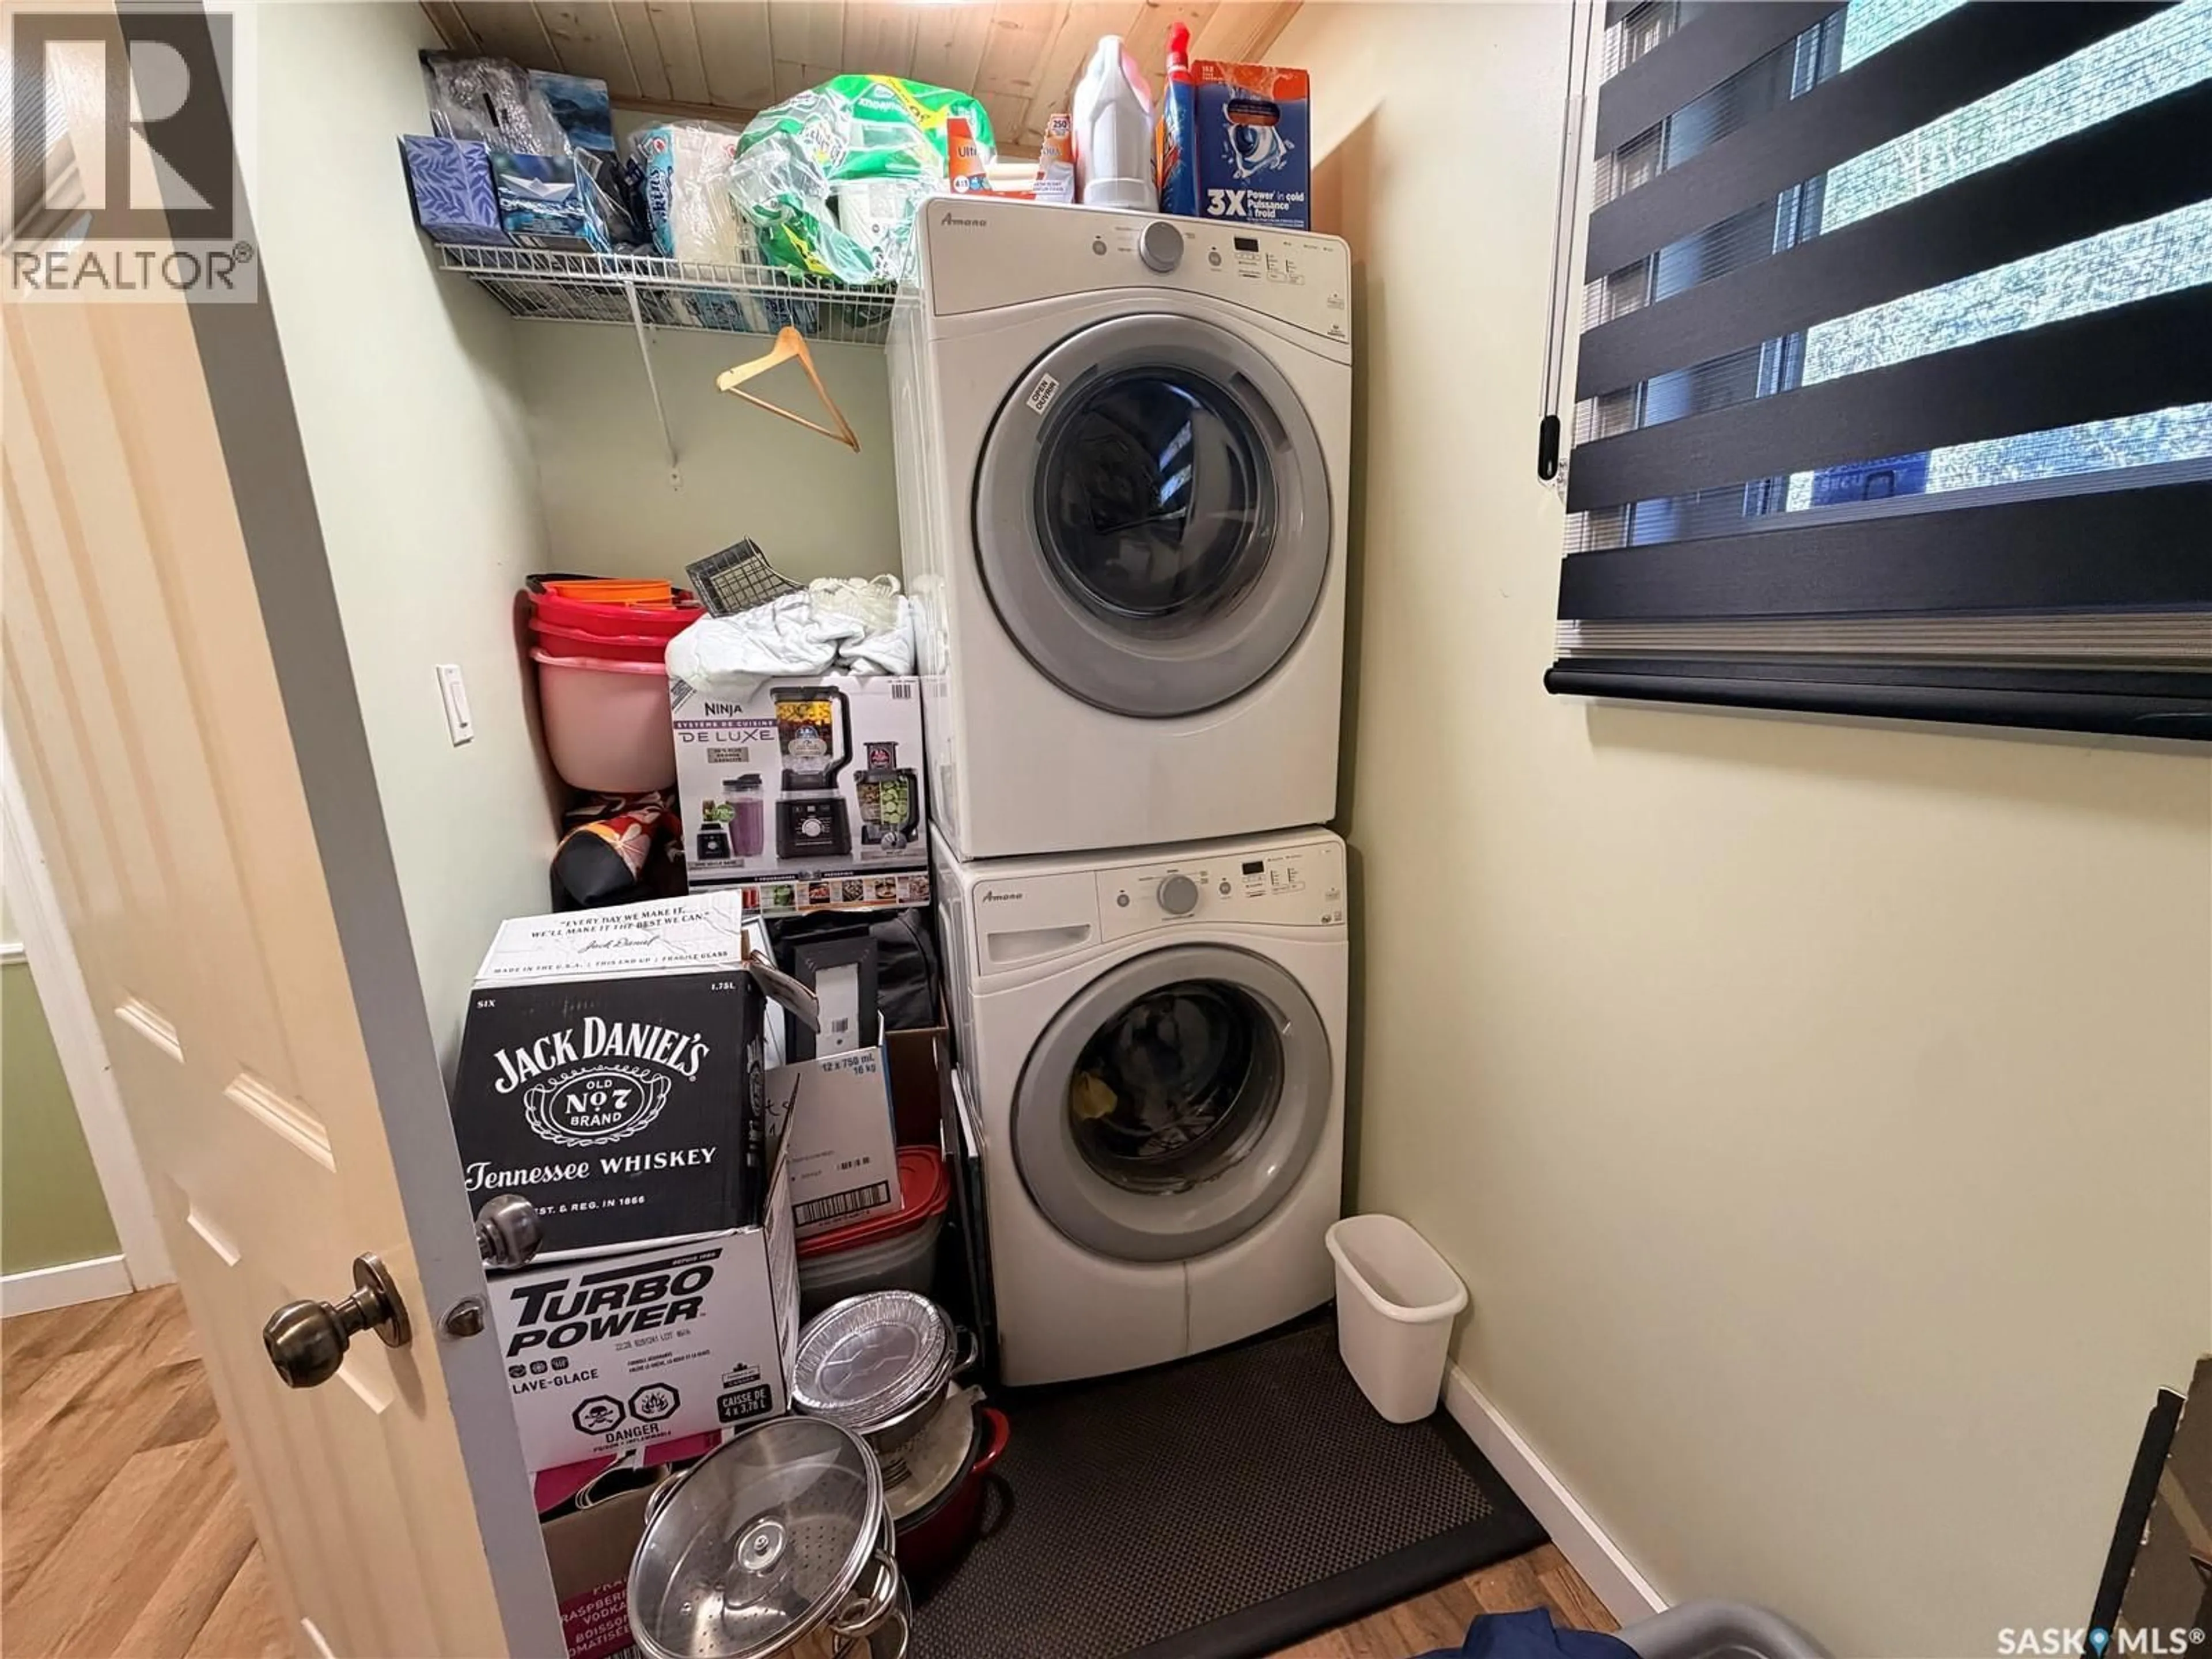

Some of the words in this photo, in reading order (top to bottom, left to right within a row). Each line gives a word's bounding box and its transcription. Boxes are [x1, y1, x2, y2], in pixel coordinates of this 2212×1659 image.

[1207, 188, 1247, 216] 3X
[1247, 190, 1274, 200] Power
[1277, 191, 1285, 201] in
[1286, 192, 1305, 202] cold
[1248, 199, 1290, 210] Puissance
[941, 213, 988, 227] Amana
[1255, 209, 1276, 218] froid
[1032, 380, 1048, 402] OPEN
[704, 702, 743, 717] NINJA
[982, 890, 1023, 904] Amana
[603, 915, 622, 924] DAY
[624, 913, 639, 921] WE
[641, 910, 670, 920] MAKE
[566, 926, 596, 935] MAKE
[636, 919, 661, 929] BEST
[711, 982, 736, 991] 1.75L
[476, 999, 496, 1009] SIX
[494, 1028, 578, 1094] JACK
[584, 1016, 710, 1078] DANIEL'S
[842, 1056, 859, 1068] 750
[586, 1078, 613, 1090] OLD
[612, 1088, 633, 1110] 7
[570, 1112, 622, 1127] BRAND
[464, 1160, 590, 1192] Tennessee
[600, 1146, 718, 1175] WHISKEY
[571, 1200, 600, 1211] REG.
[602, 1198, 616, 1208] IN
[619, 1195, 646, 1206] 1866
[510, 1265, 714, 1327] TURBO
[506, 1296, 703, 1357] POWER
[512, 1368, 599, 1395] LAVE-GLACE
[722, 1392, 752, 1408] CAISSE
[754, 1388, 766, 1400] DE
[724, 1407, 731, 1417] 4
[760, 1399, 766, 1408] L
[605, 1422, 660, 1444] DANGER
